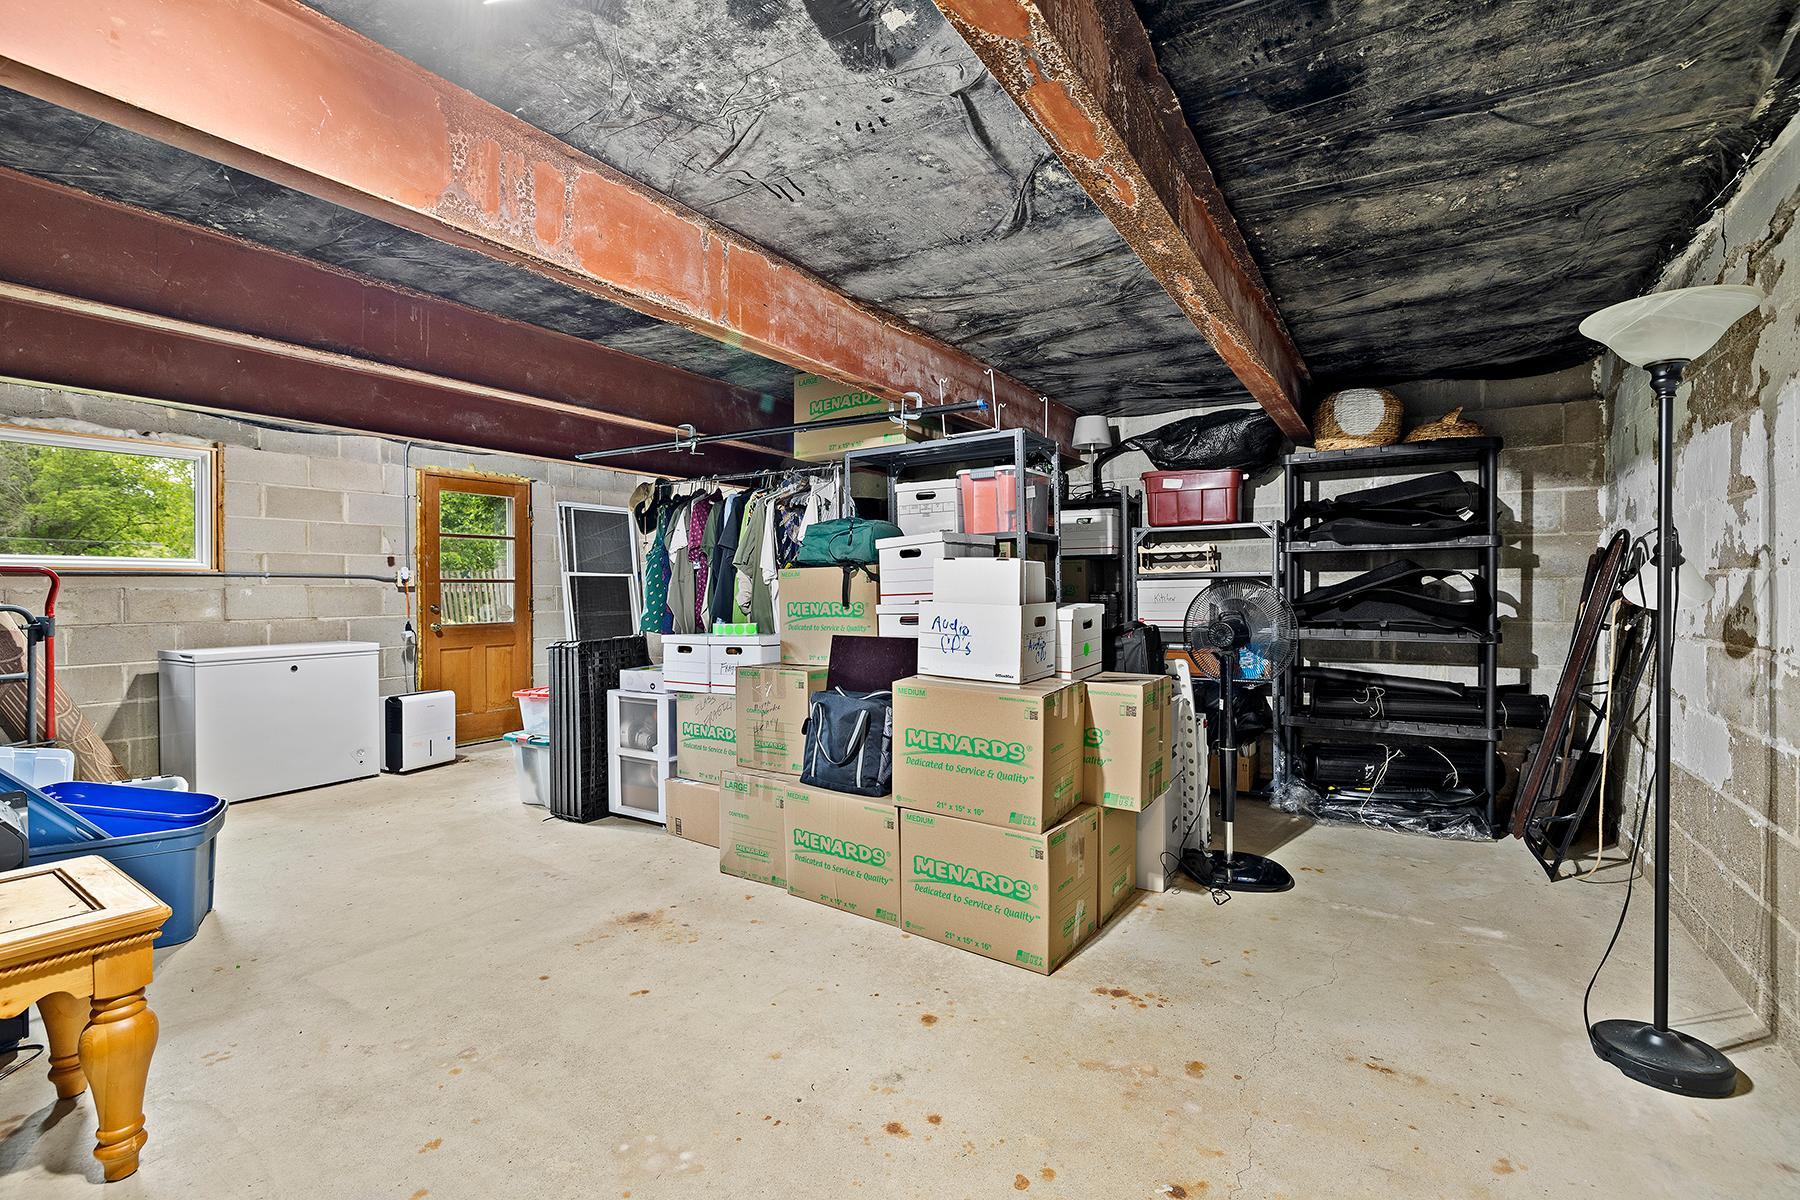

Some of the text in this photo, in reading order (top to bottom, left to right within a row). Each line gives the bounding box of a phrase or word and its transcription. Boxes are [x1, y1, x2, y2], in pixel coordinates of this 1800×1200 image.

[787, 601, 865, 618] MENARDS
[820, 624, 838, 632] Service
[931, 615, 970, 636] Audio
[897, 688, 926, 697] MEDIUM
[905, 728, 1025, 763] MENARDS
[906, 756, 1029, 784] Dedicated to Service & Quality
[724, 780, 748, 792] LARGE
[787, 792, 809, 801] MEDIUM
[906, 814, 934, 825] MEDIUM
[793, 828, 886, 867] MENARDS
[795, 853, 889, 886] Dedicated to Service & Quality
[913, 855, 1032, 901] MENARDS
[914, 883, 1035, 923] Dedicated to Service & Quality
